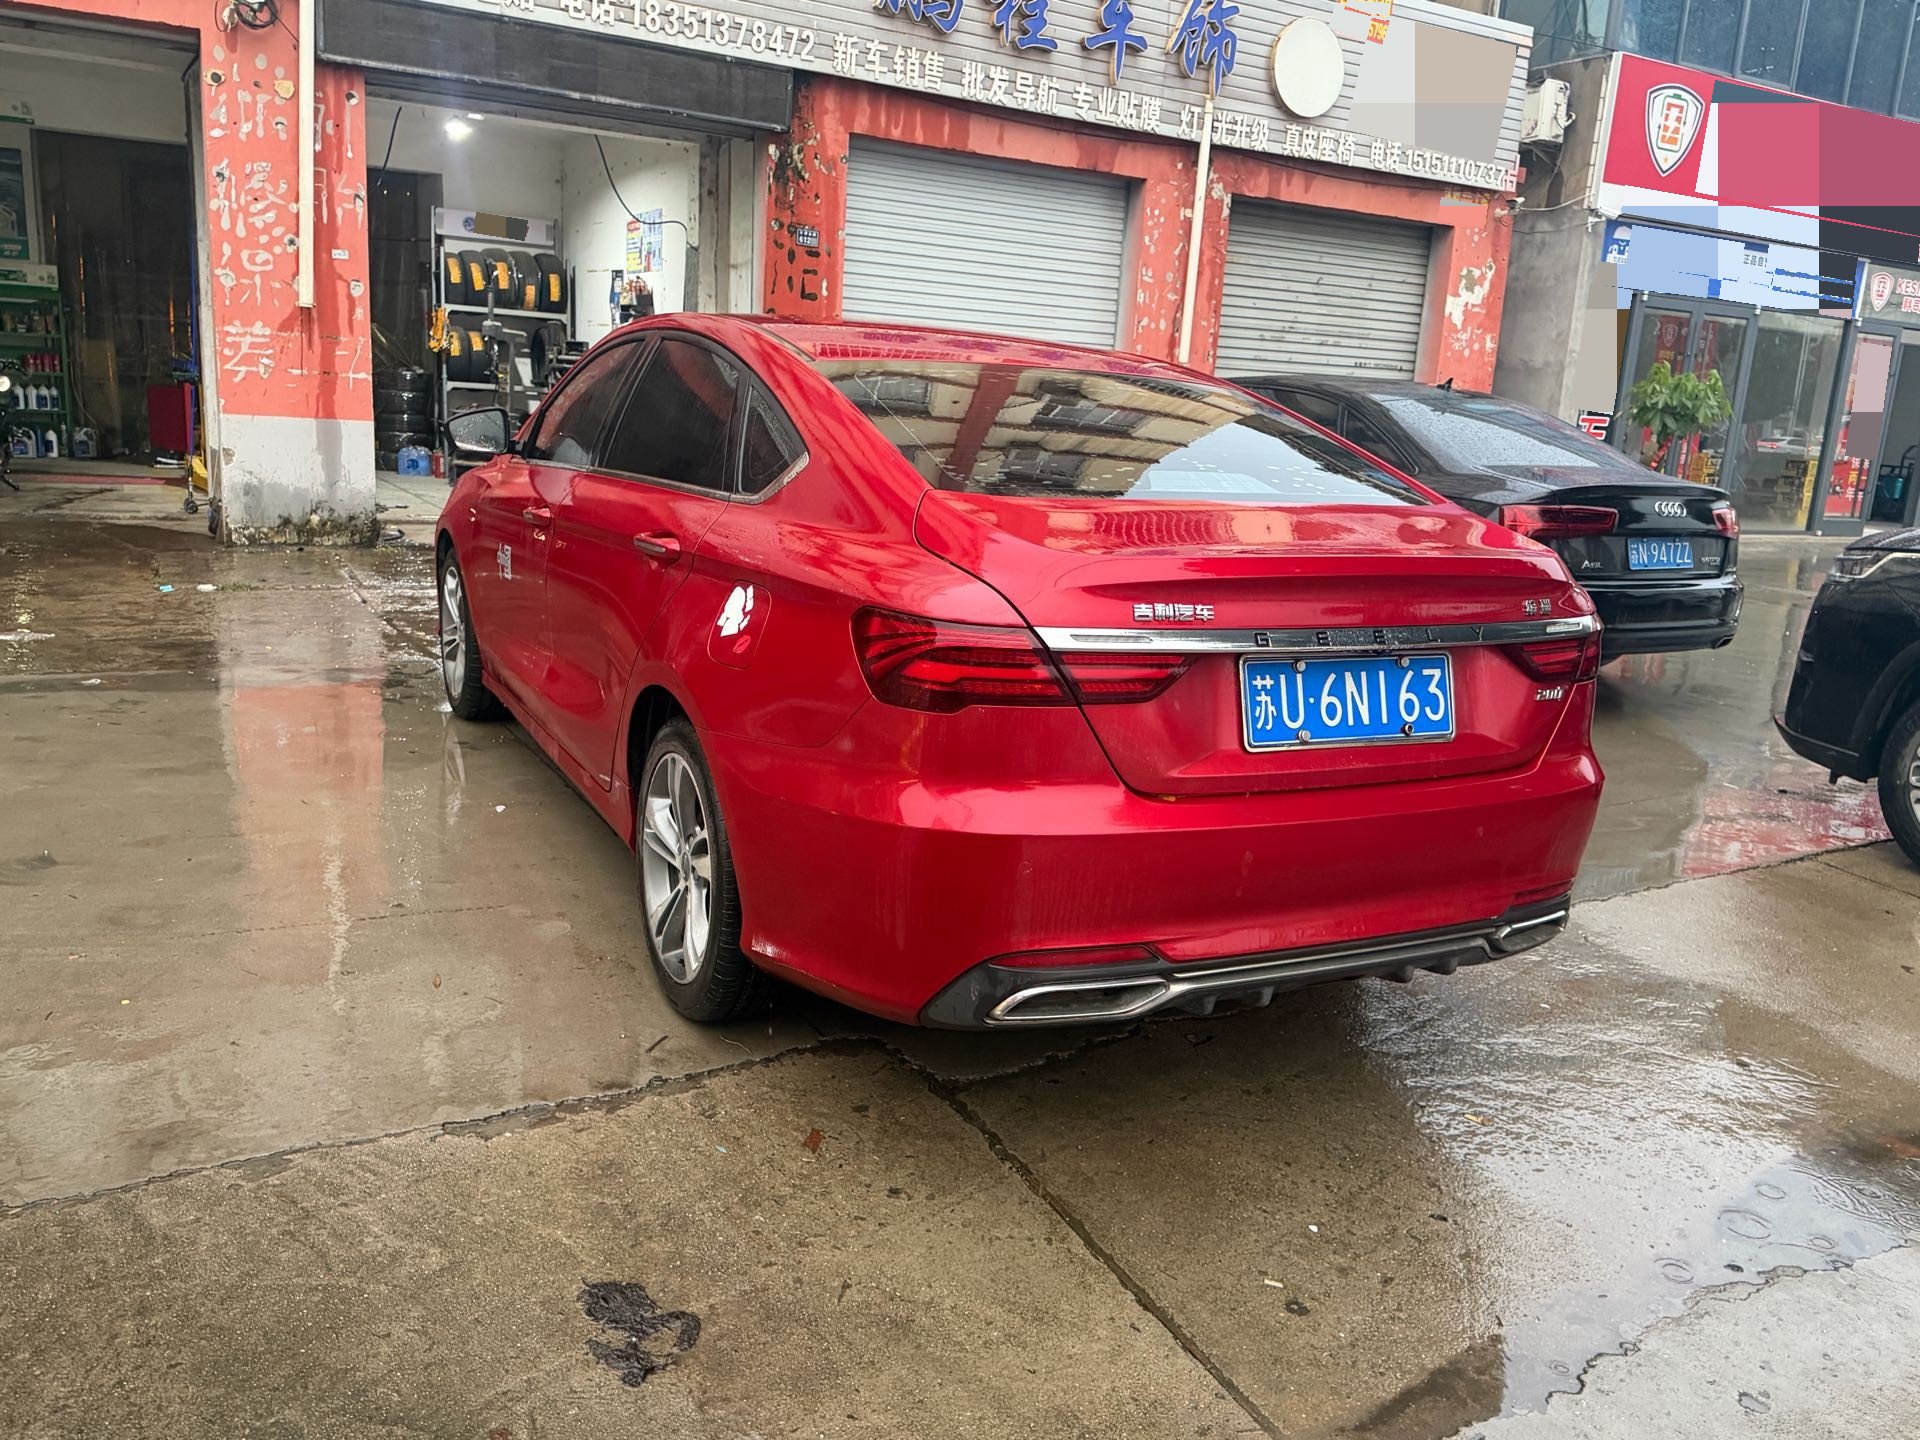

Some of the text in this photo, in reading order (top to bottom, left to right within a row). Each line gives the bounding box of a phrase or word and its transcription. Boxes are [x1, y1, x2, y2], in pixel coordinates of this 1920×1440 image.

[832, 32, 945, 91] 新车销售
[961, 60, 1061, 114] 批发导航
[1073, 83, 1162, 134] 专业贴膜
[1178, 104, 1270, 152] 灯光升级
[1283, 123, 1356, 167] 真皮座椅
[1132, 603, 1215, 621] 吉利汽车
[1253, 626, 1484, 648] GEELY
[1251, 667, 1446, 731] 苏U·6N163
